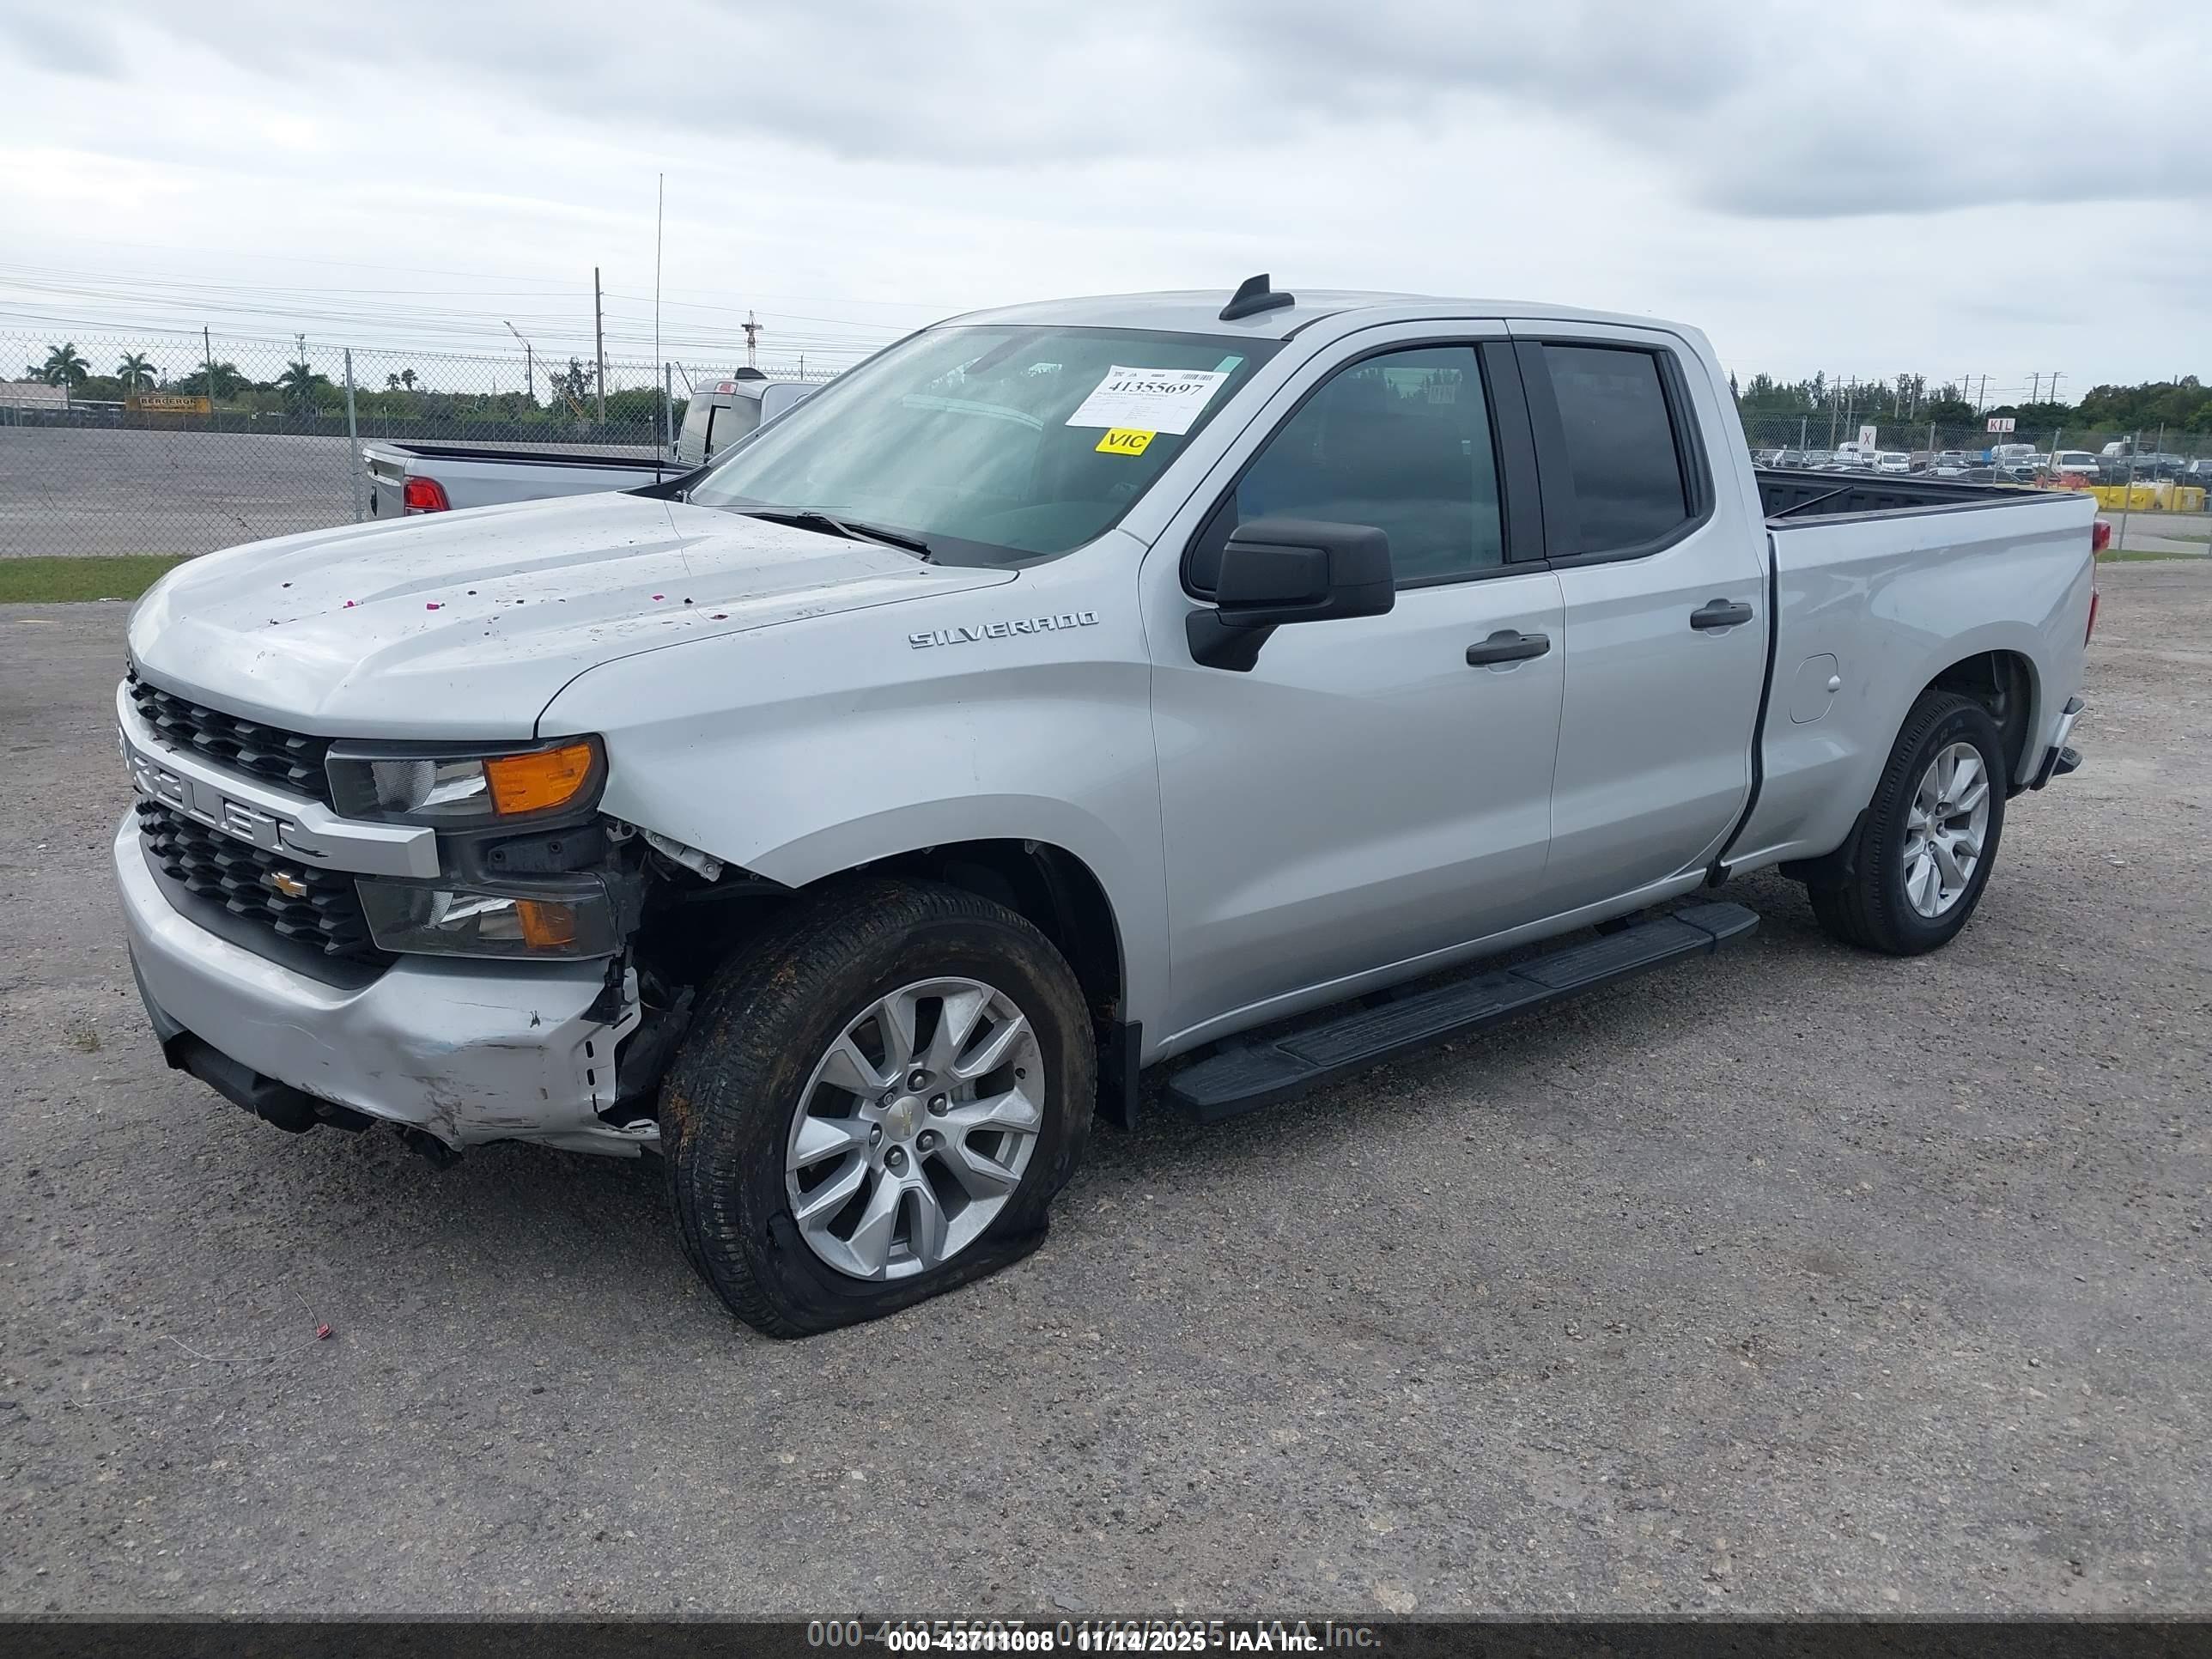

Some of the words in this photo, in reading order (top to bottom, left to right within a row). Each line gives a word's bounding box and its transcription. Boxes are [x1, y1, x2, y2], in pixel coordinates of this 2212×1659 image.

[1109, 381, 1205, 397] 41355697
[1109, 433, 1147, 447] VIC
[1863, 432, 1872, 445] X
[908, 611, 1100, 649] SILVERADO
